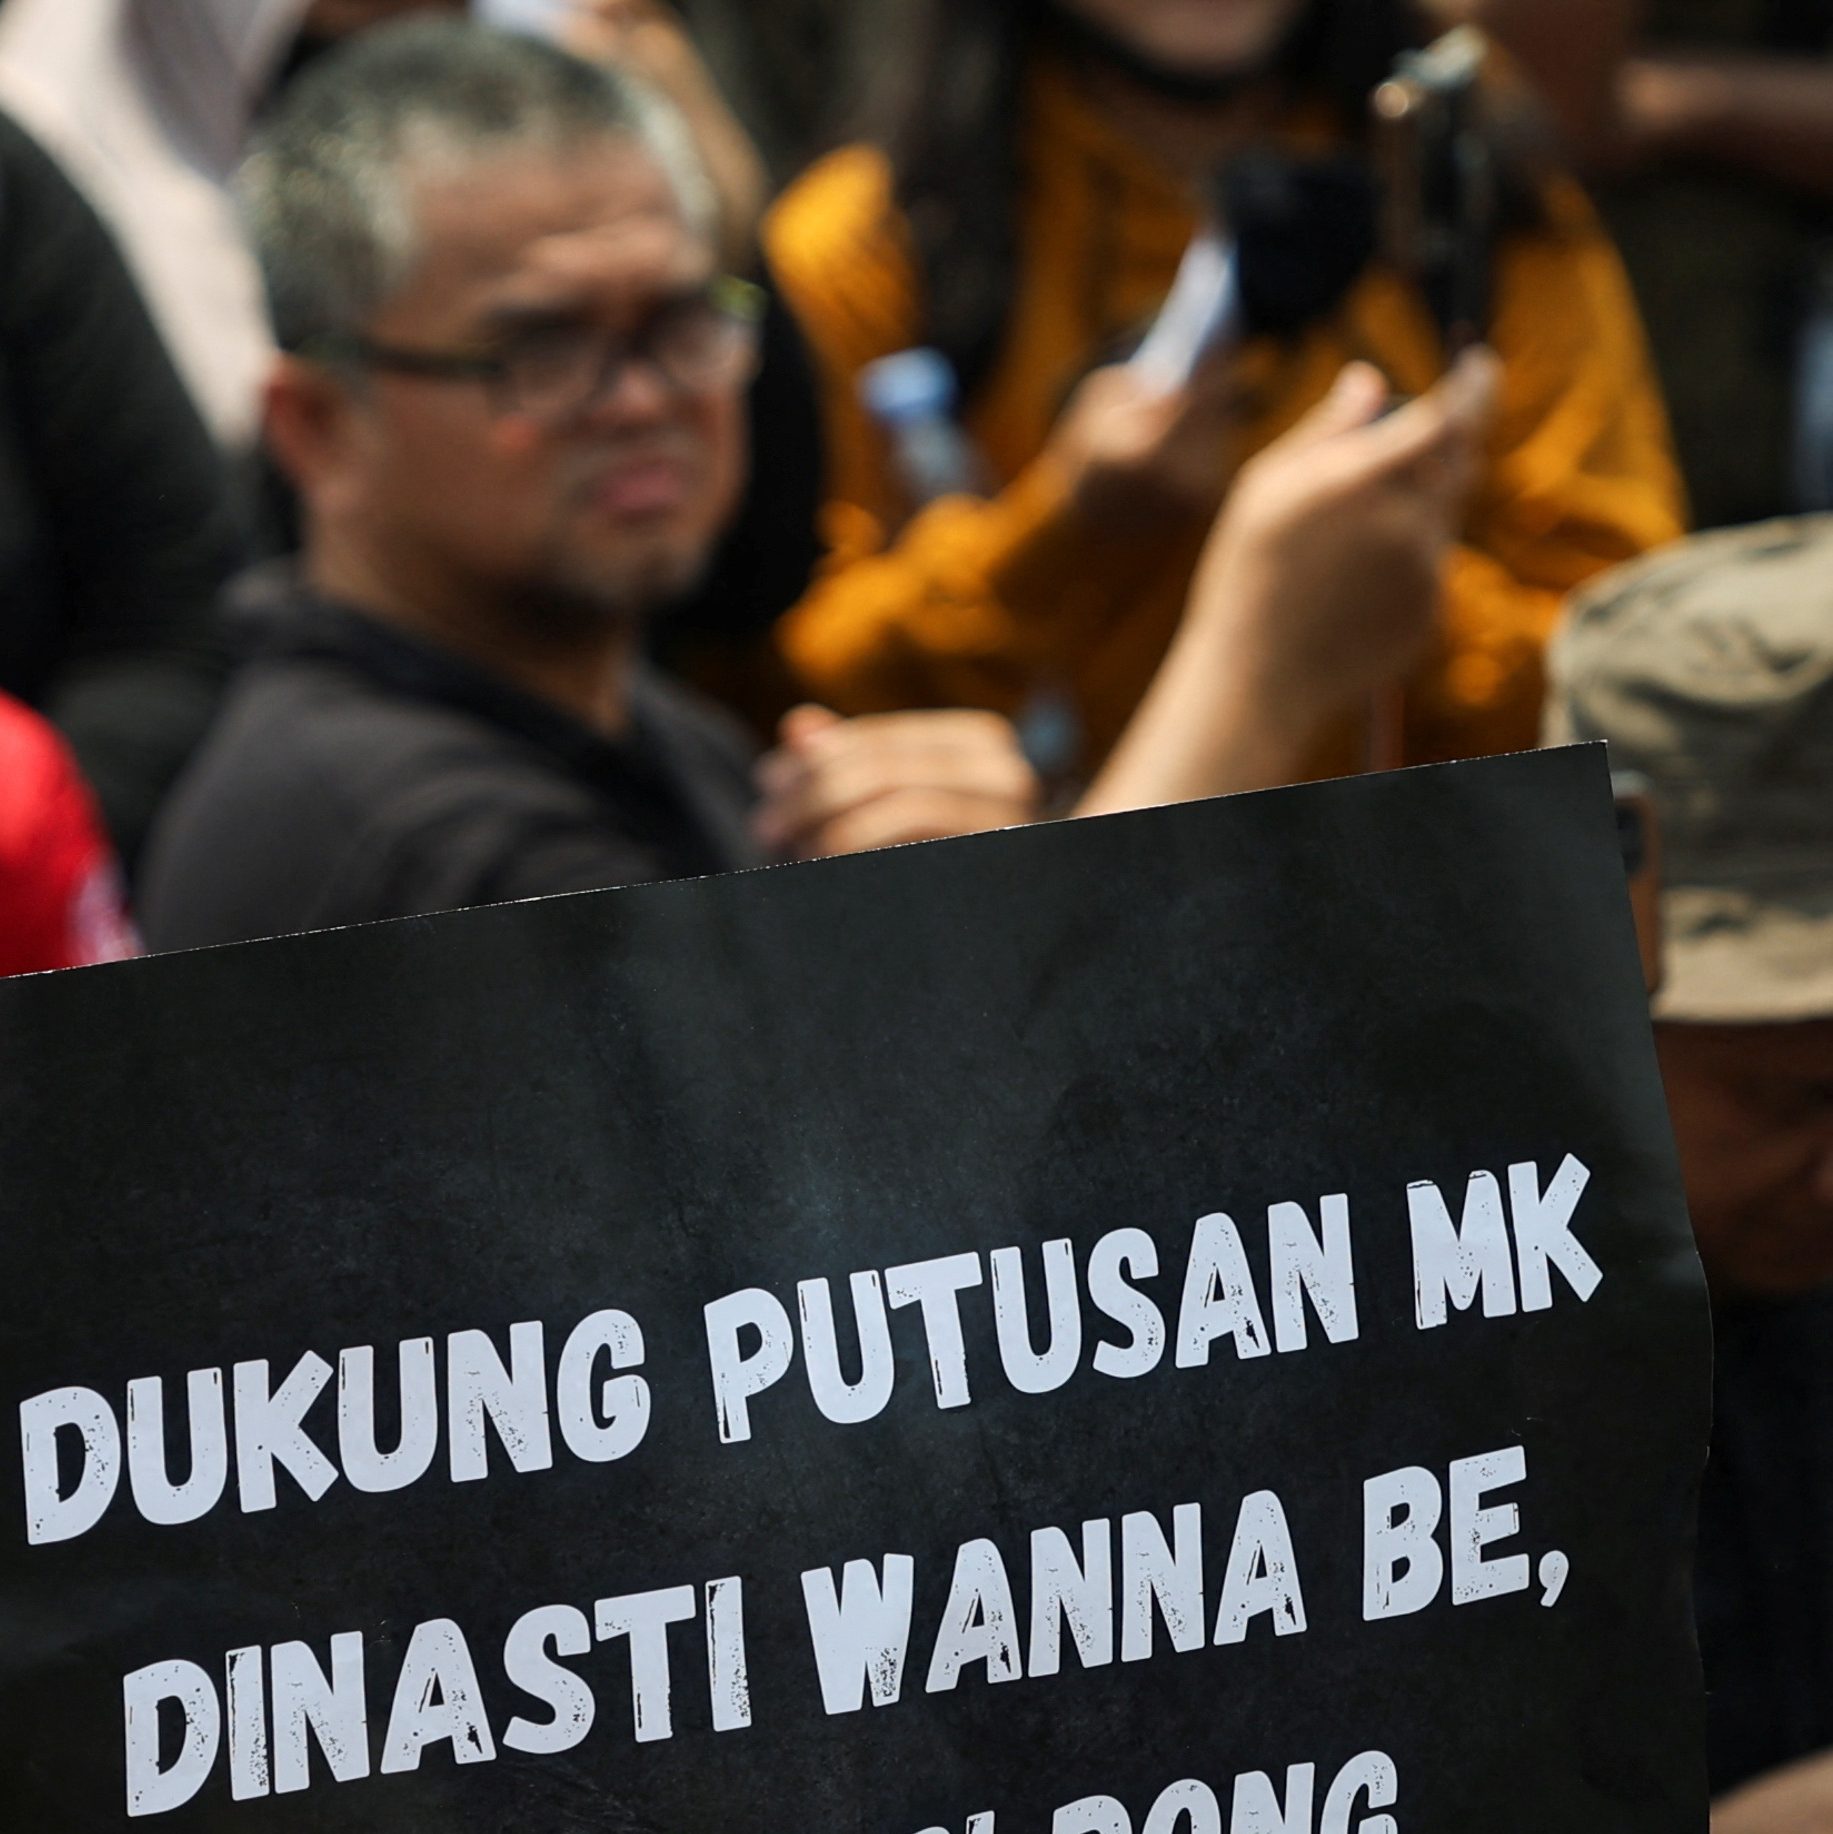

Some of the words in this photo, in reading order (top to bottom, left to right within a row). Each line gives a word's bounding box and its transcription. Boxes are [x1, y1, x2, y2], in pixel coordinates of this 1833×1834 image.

[20, 1309, 650, 1546] DUKUNG
[704, 1193, 1358, 1443] PUTUSAN
[1407, 1153, 1603, 1330] MK
[123, 1576, 752, 1817] DINASTI
[801, 1490, 1307, 1716] WANNA
[1363, 1446, 1569, 1620] BE,
